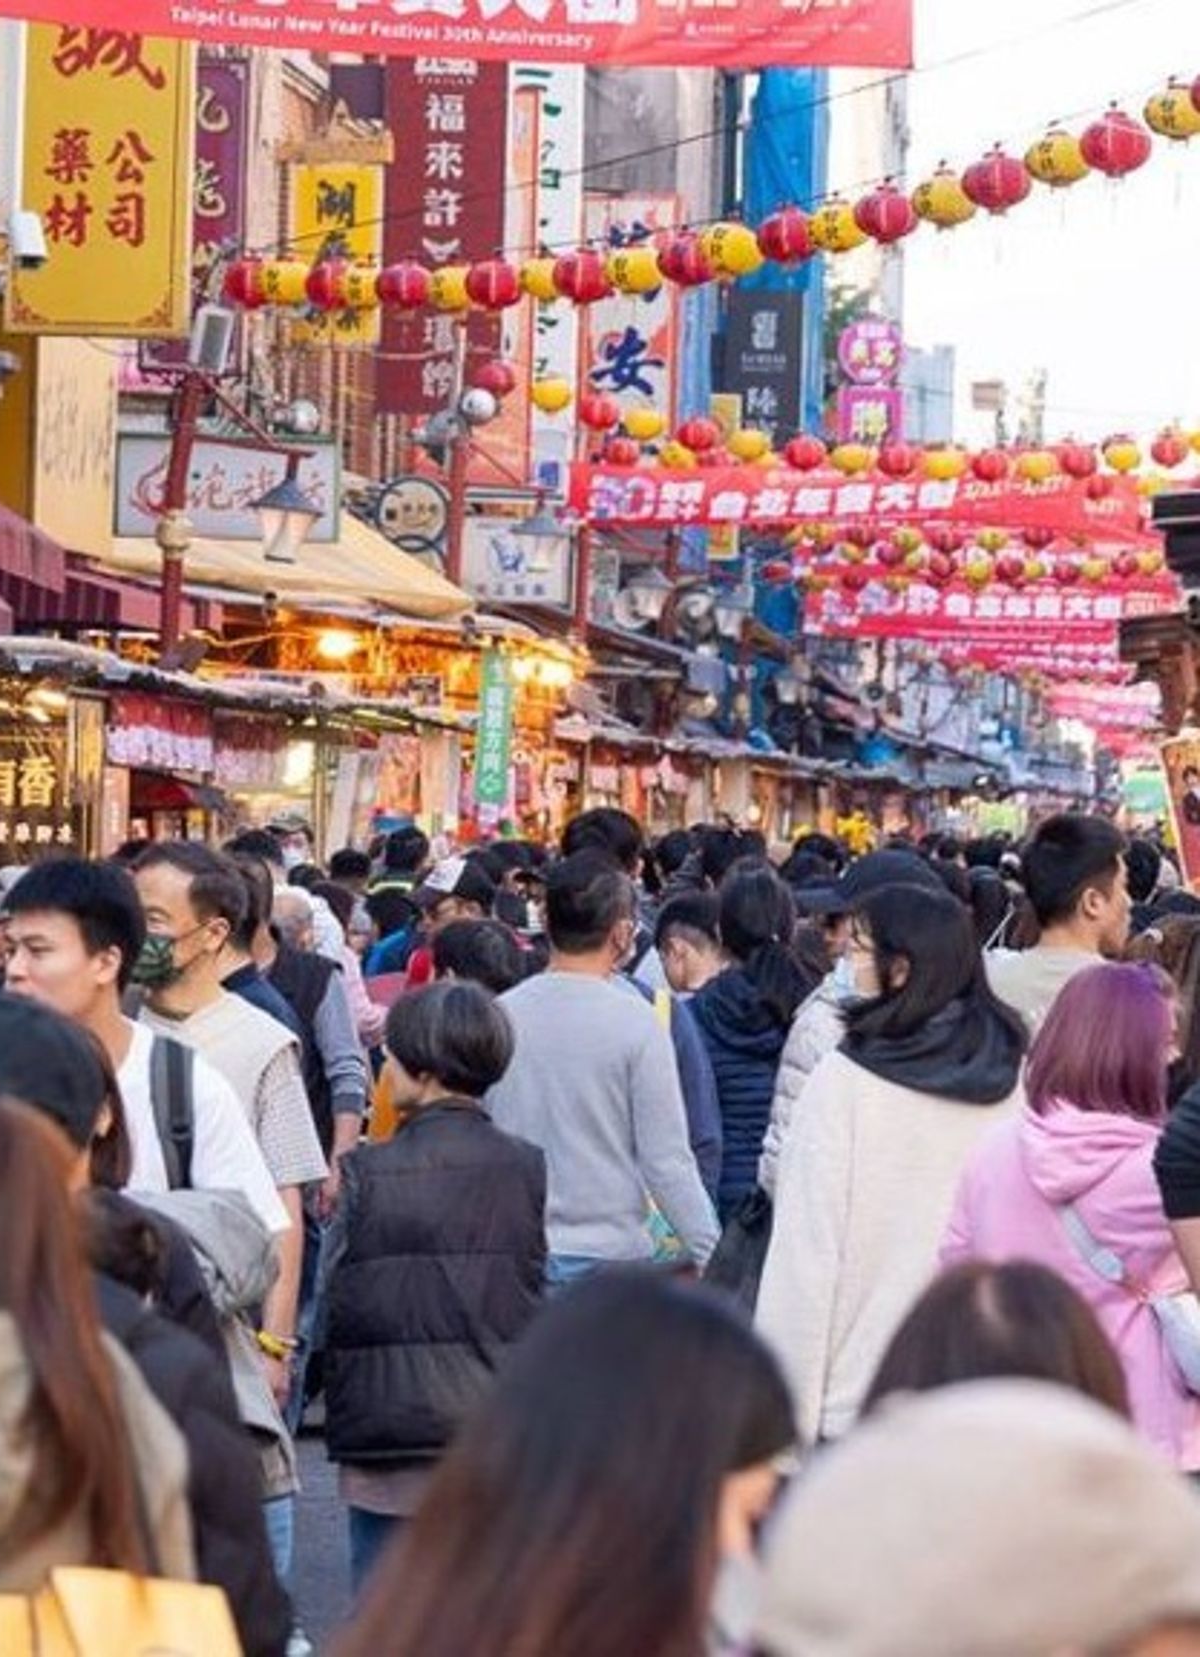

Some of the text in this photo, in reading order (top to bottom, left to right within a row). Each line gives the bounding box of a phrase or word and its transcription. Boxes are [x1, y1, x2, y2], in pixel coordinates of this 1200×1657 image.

[170, 8, 596, 50] Taipei Lunar New Year Festival 30th Anniversary
[44, 129, 96, 246] 藥材
[105, 131, 155, 246] 公司
[424, 93, 465, 226] 福來許
